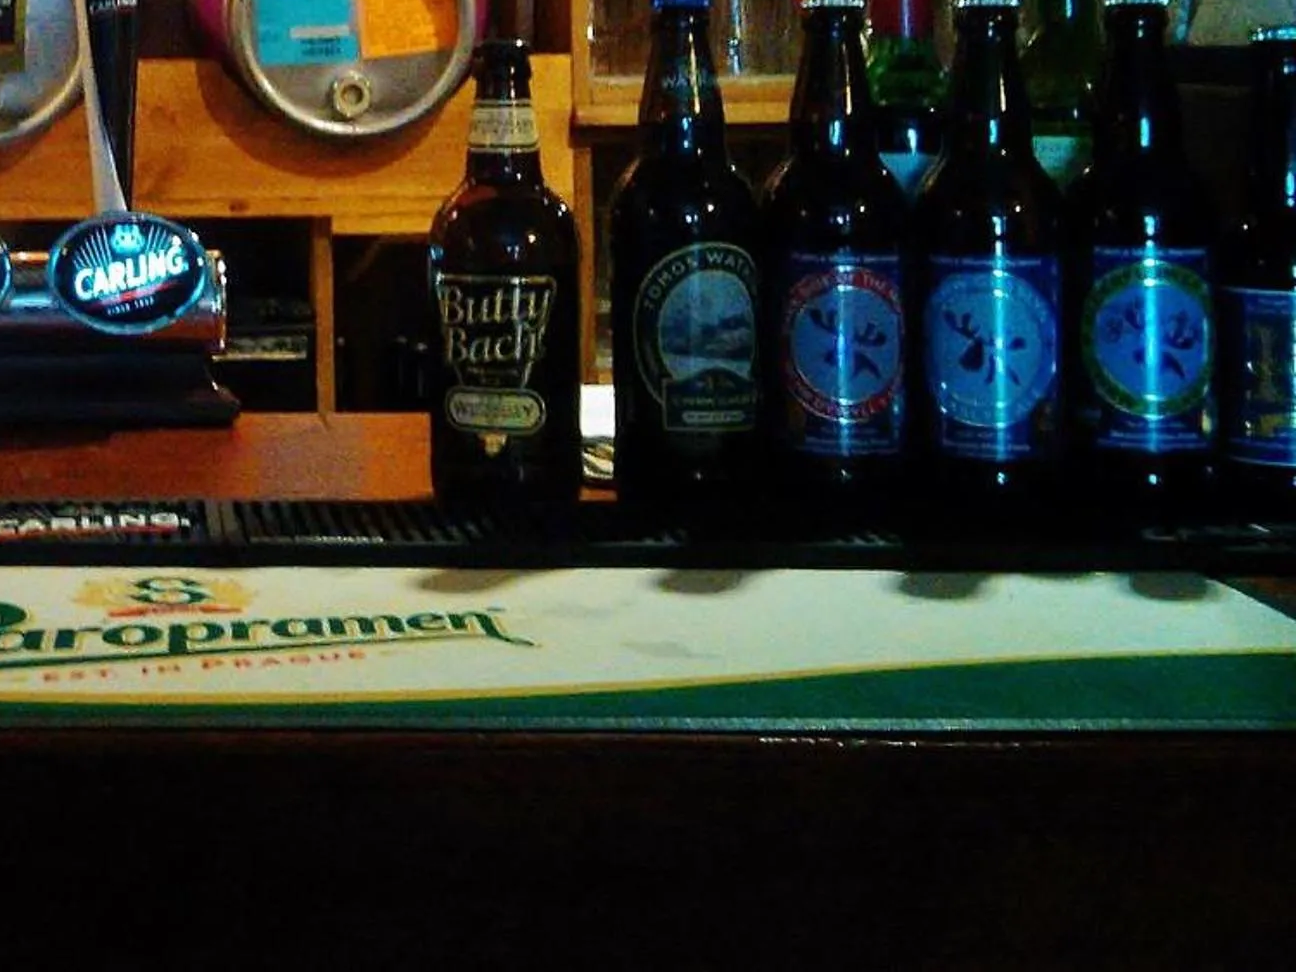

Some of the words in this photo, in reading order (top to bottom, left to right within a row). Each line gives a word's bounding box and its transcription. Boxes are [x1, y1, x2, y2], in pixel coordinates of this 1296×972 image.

[73, 245, 184, 302] CARLING
[442, 284, 553, 333] Butty
[448, 326, 544, 362] Bach
[200, 648, 366, 671] PRAGUE
